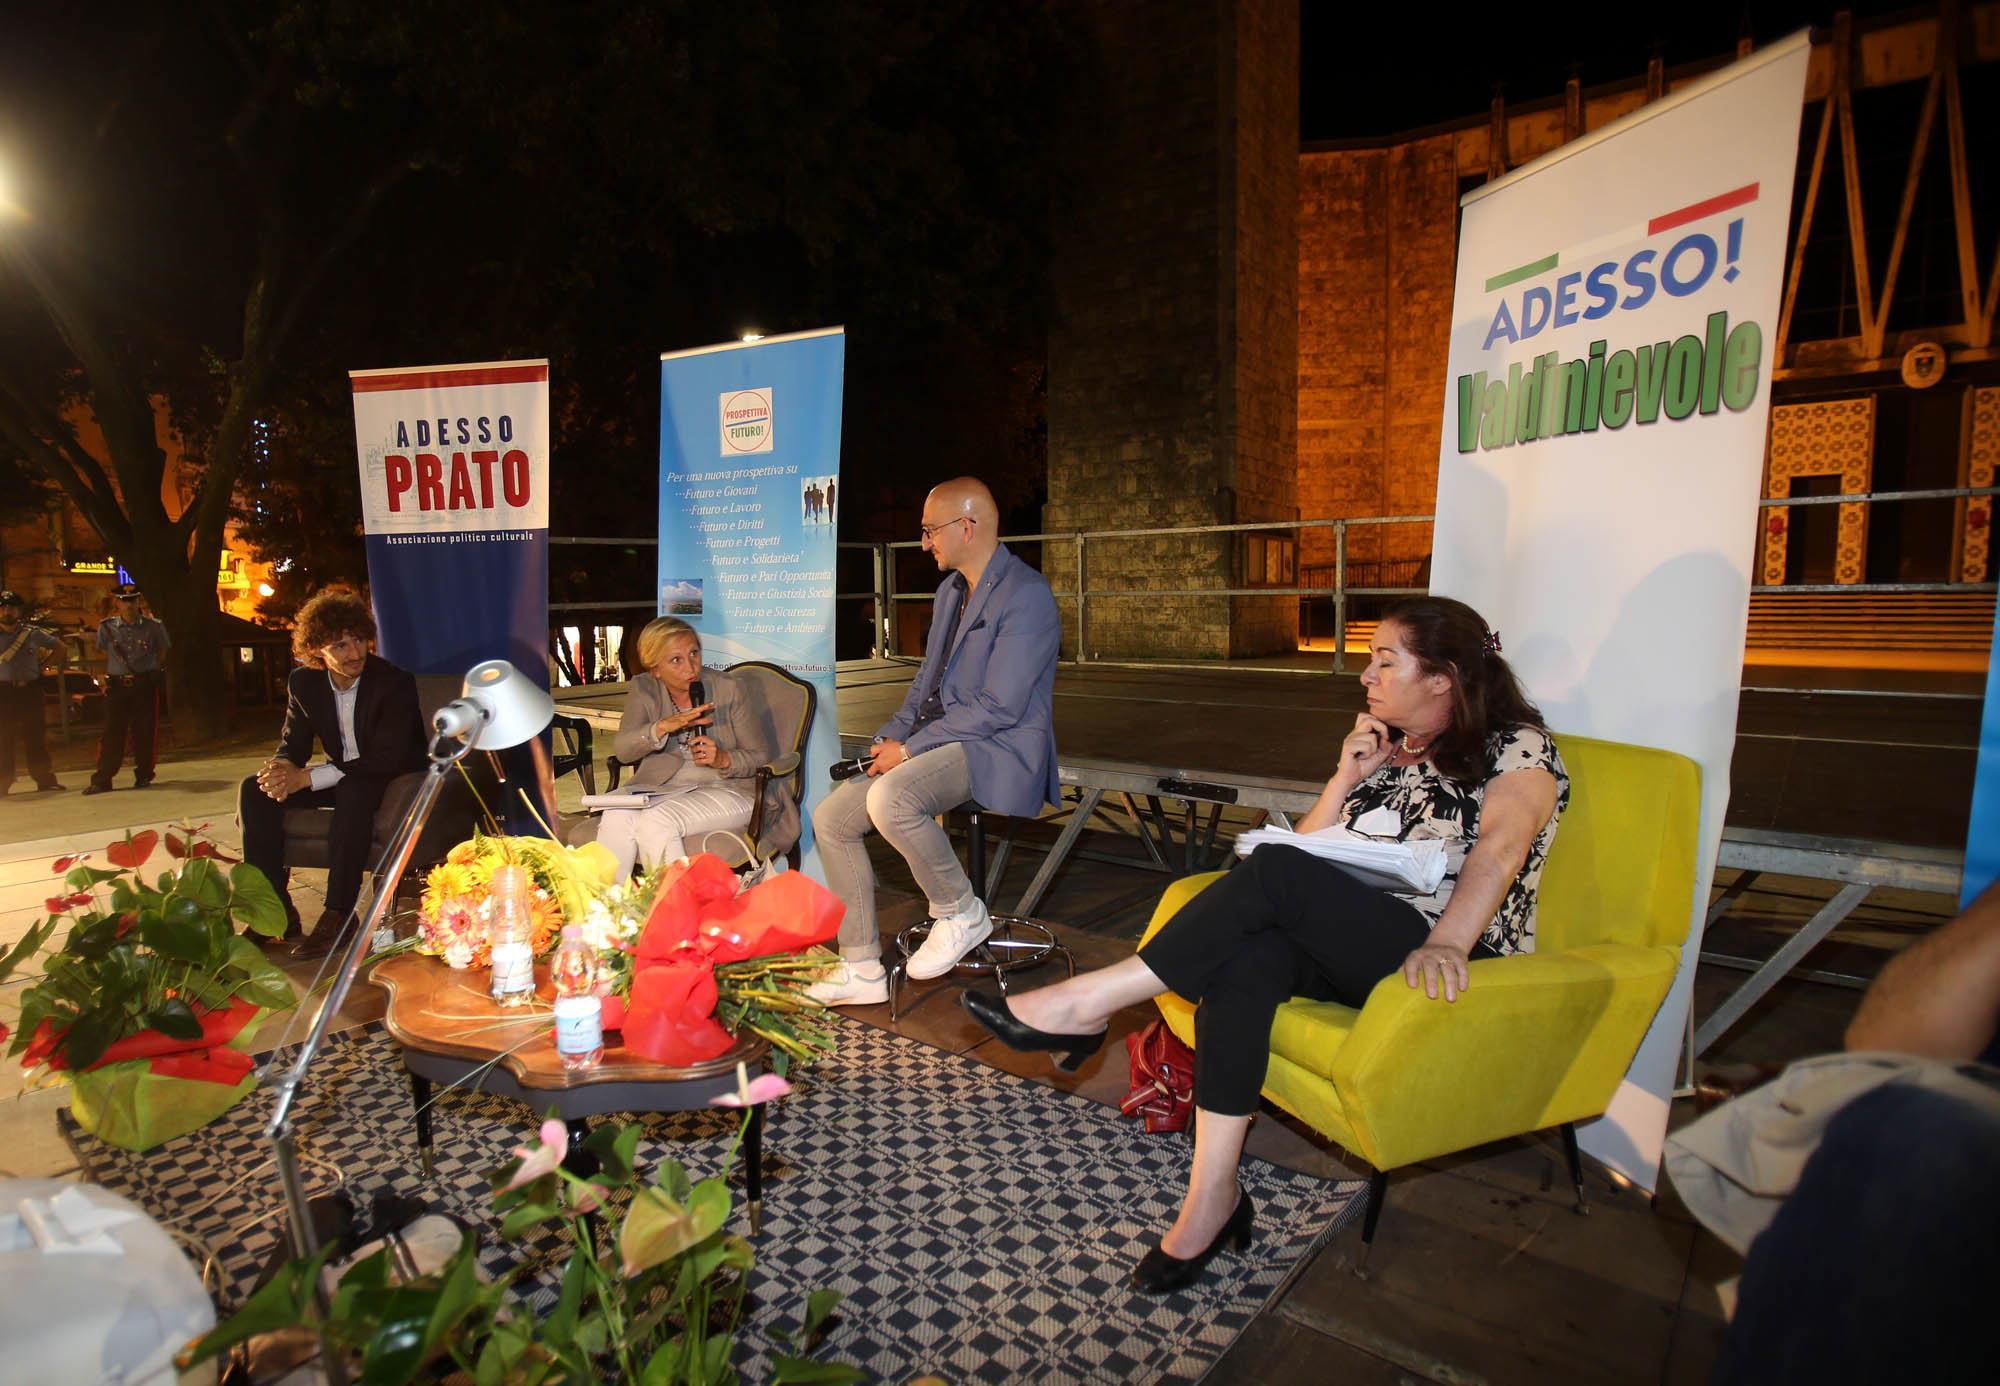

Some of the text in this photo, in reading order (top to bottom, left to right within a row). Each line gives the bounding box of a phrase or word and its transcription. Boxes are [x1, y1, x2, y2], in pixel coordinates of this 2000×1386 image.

[1482, 218, 1744, 350] ADESSO!
[1458, 311, 1762, 453] Valdinievole
[726, 407, 768, 420] PROSPETTIVA
[397, 415, 513, 448] ADESSO
[731, 426, 764, 438] FUTURO!
[666, 465, 798, 483] Per una nuova prospettiva su
[385, 450, 531, 512] PRATO
[723, 484, 759, 497] Giovani
[730, 502, 762, 513] Lavoro
[737, 518, 765, 530] Diritti
[387, 535, 446, 545] Associazione
[490, 530, 534, 541] culturale
[744, 535, 781, 549] Progetti
[759, 571, 777, 583] Pari
[767, 587, 806, 600] Giustizia
[774, 606, 817, 617] Sicurezza
[784, 622, 826, 633] Ambiente
